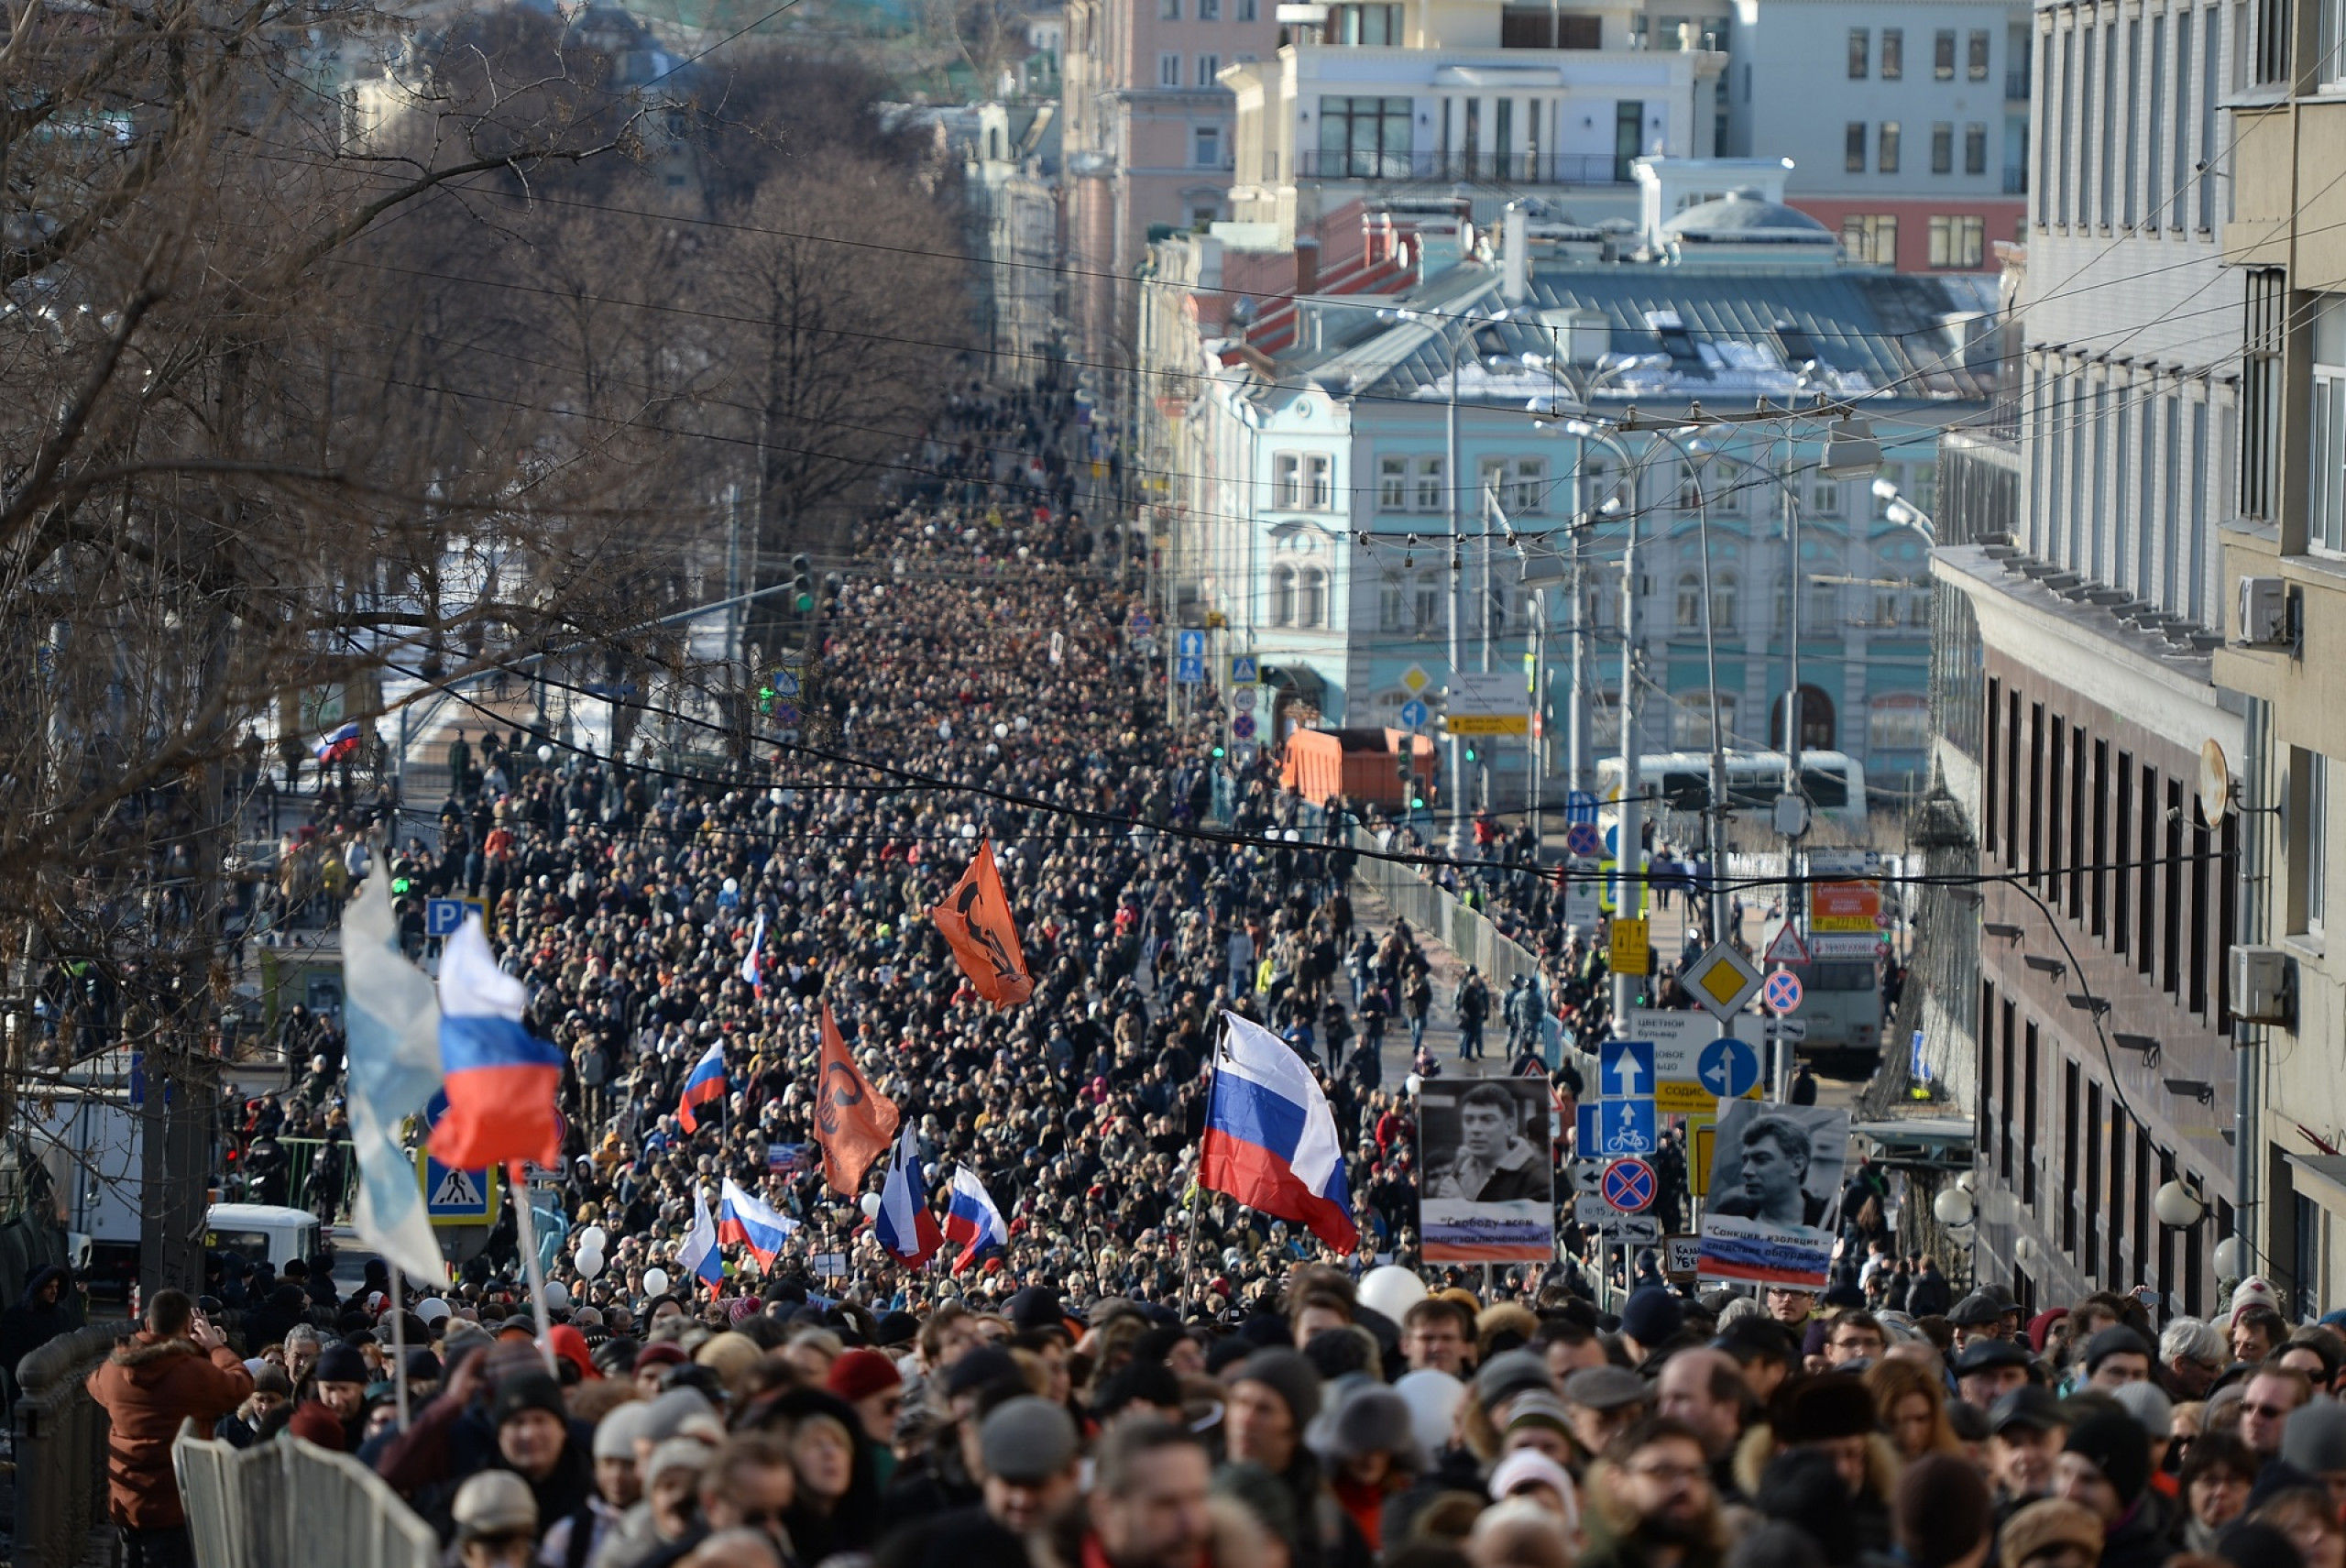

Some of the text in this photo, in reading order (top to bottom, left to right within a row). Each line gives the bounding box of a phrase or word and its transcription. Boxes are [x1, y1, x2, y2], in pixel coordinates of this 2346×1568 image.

[436, 904, 456, 932] P
[1638, 1018, 1685, 1028] ЦВЕТНОЙ
[1664, 1085, 1705, 1097] СОДИС
[1707, 1225, 1766, 1243] "Санкции,
[1766, 1234, 1819, 1246] изоляция
[1706, 1243, 1825, 1263] следствие абсурдной
